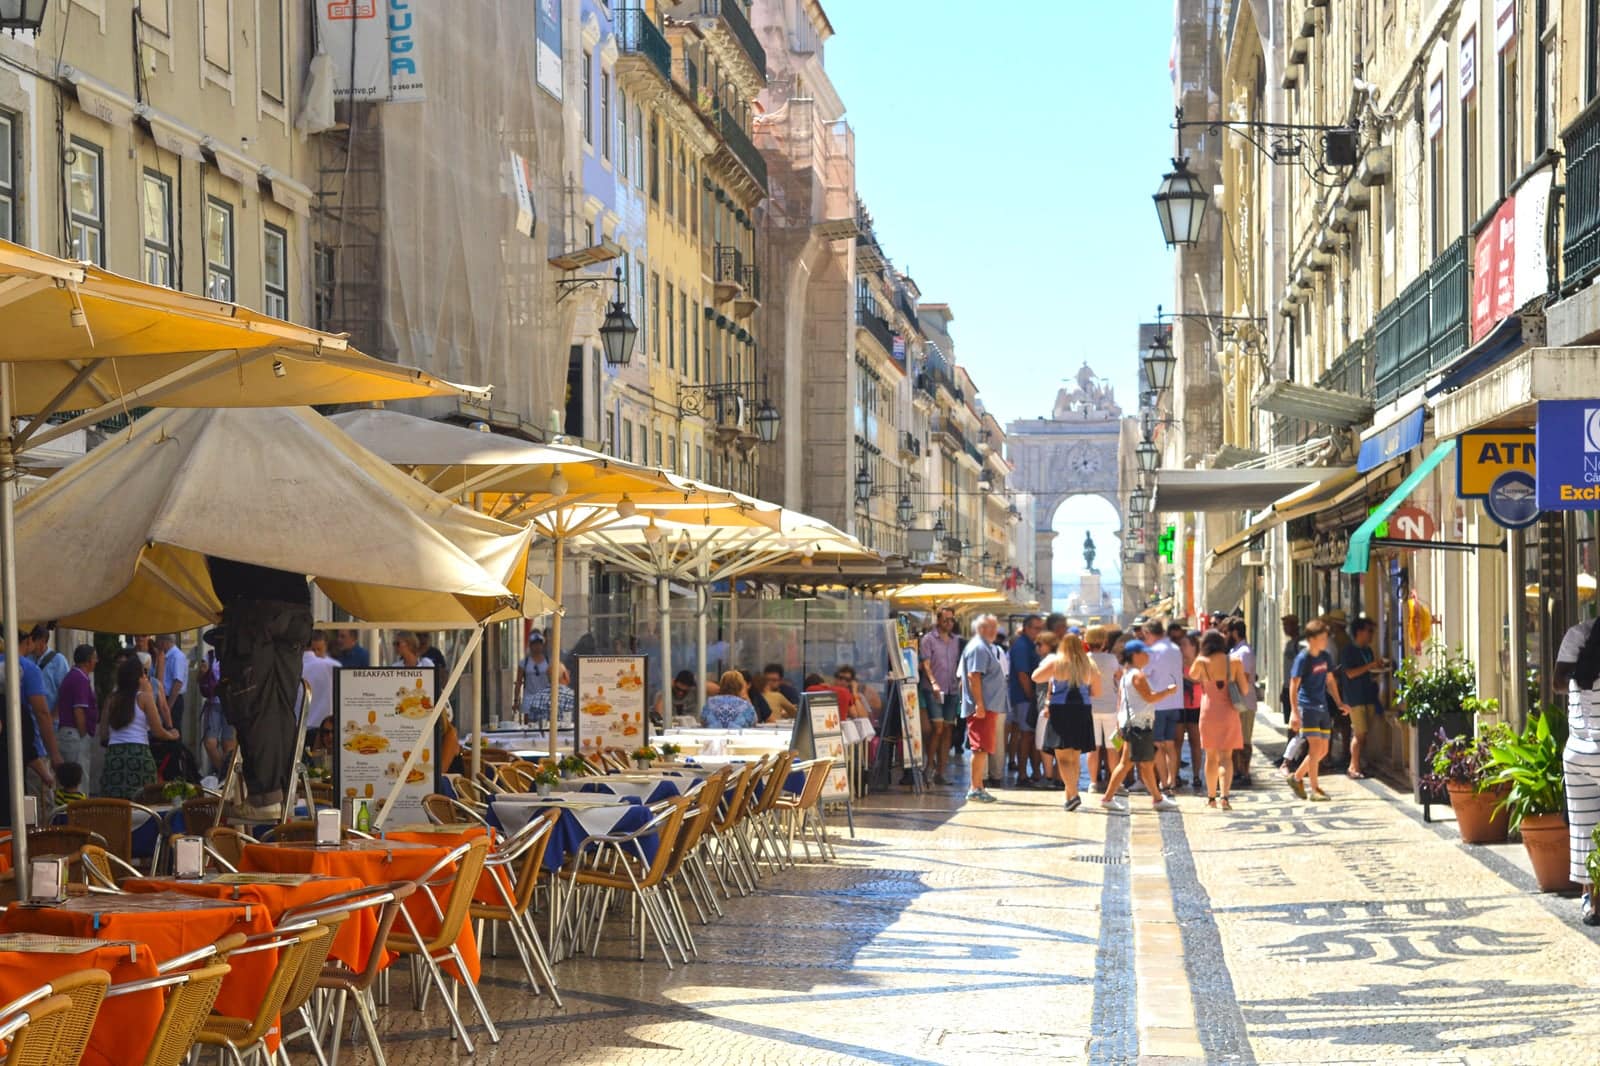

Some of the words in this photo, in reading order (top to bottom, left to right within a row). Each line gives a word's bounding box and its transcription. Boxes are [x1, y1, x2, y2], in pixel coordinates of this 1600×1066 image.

[1584, 455, 1600, 472] N
[353, 670, 394, 678] BREAKFAST
[396, 670, 423, 678] MENUS
